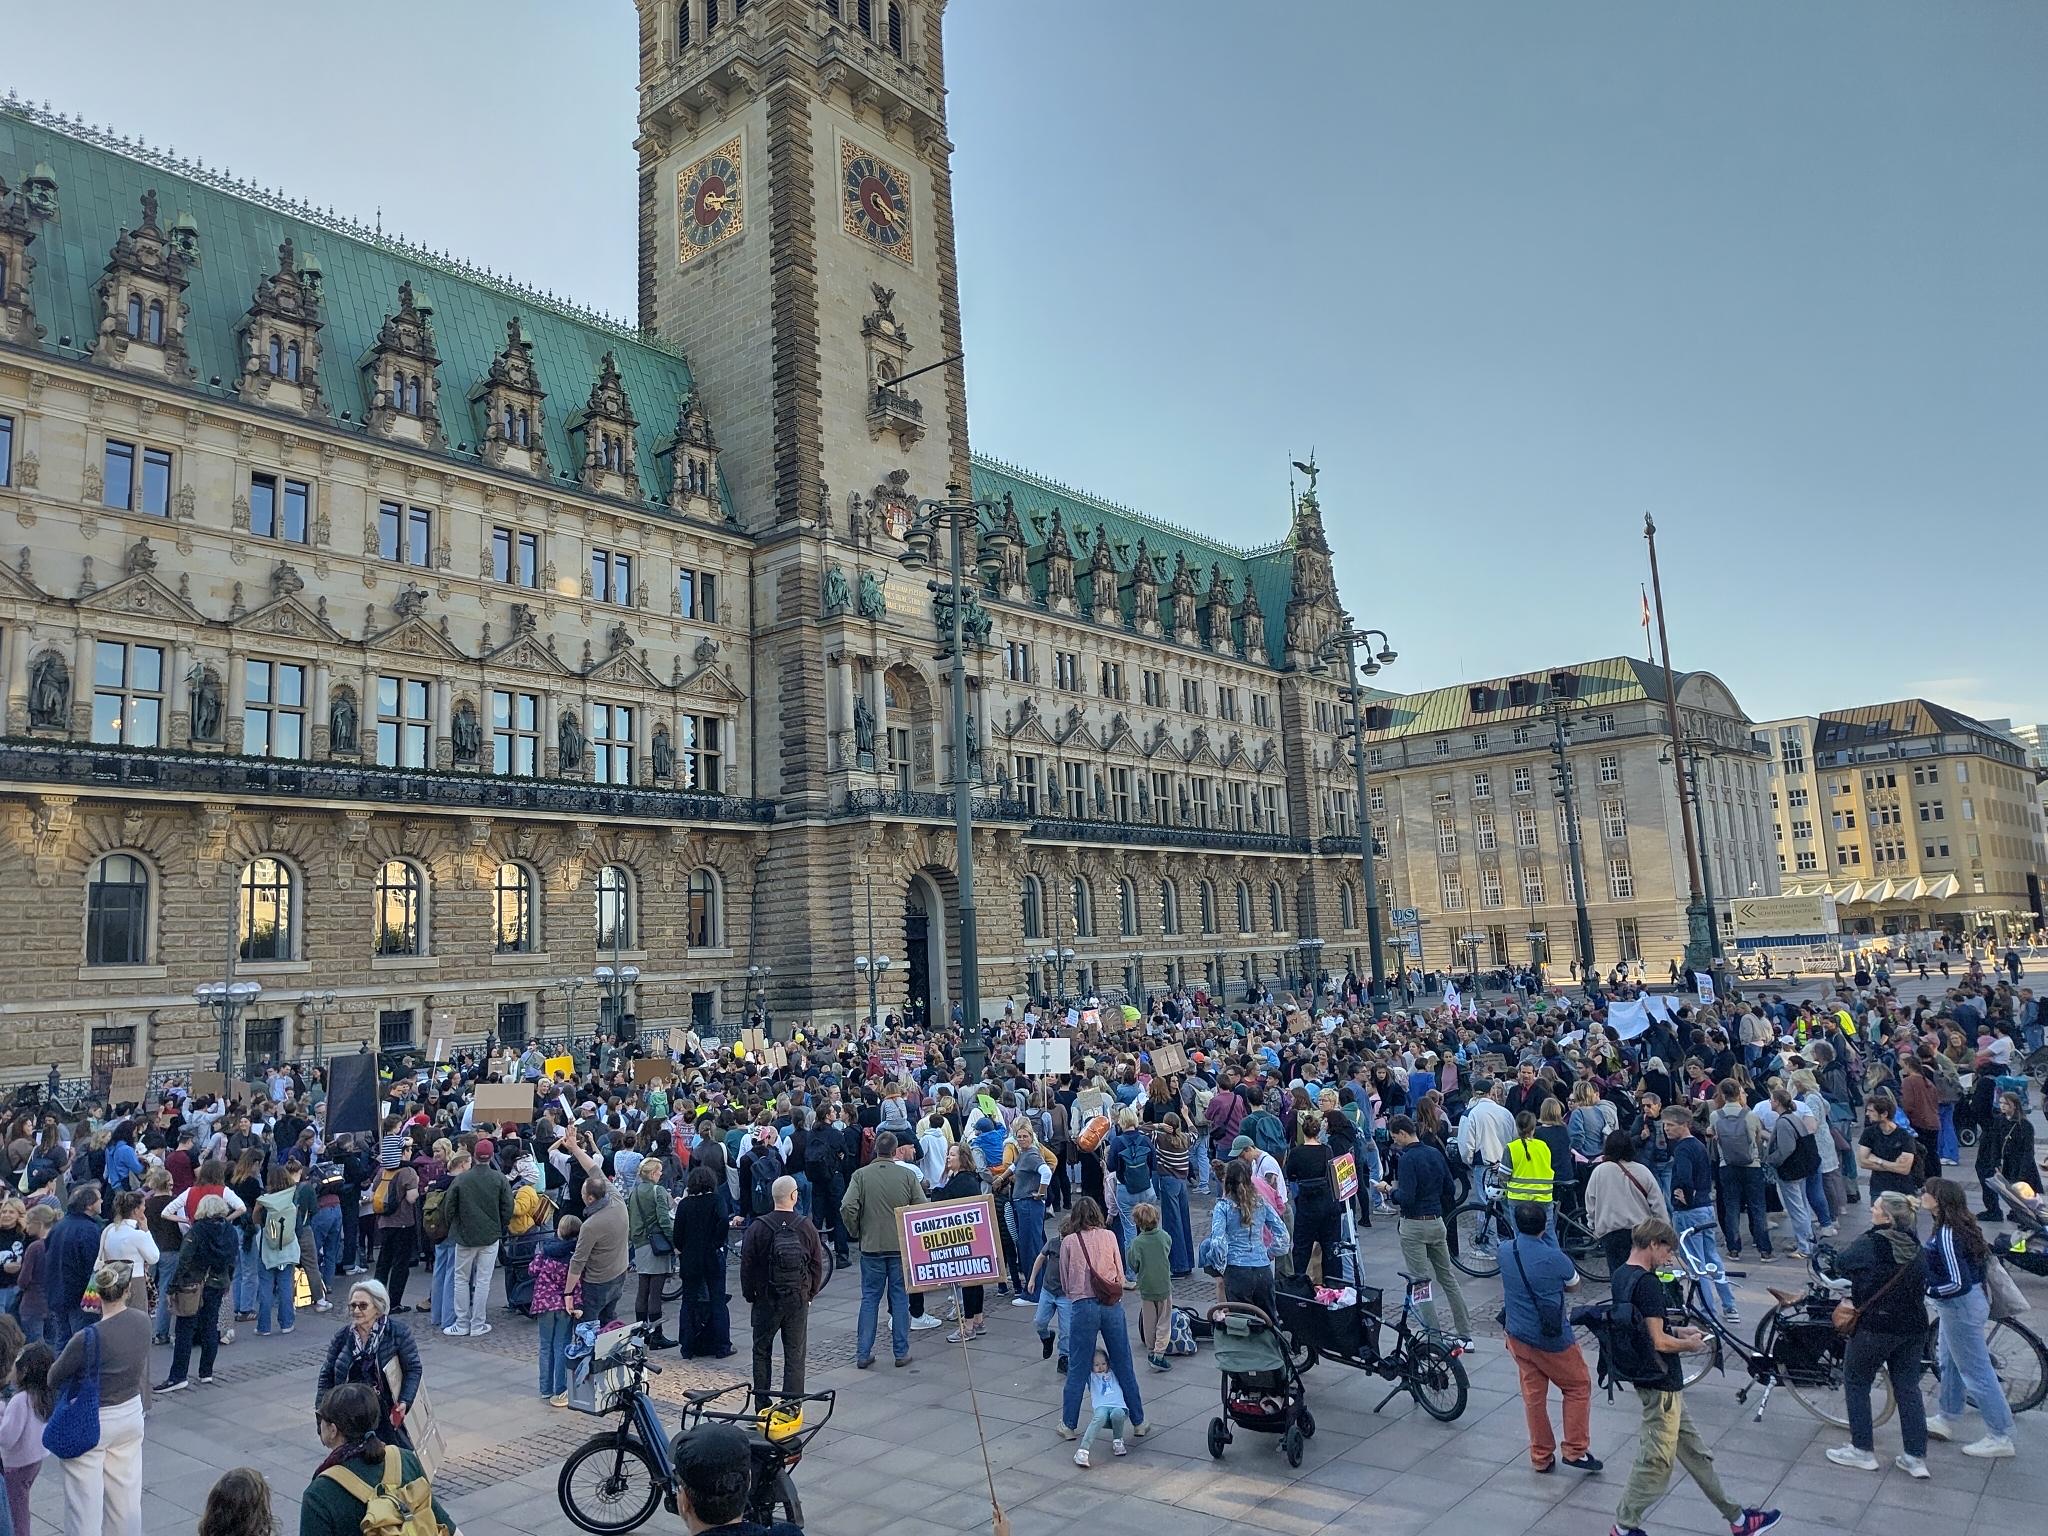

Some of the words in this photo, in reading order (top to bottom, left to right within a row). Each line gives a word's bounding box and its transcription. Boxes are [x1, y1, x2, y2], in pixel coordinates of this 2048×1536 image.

[914, 1214, 962, 1234] GANZTAG
[963, 1210, 980, 1224] IST
[922, 1226, 974, 1250] BILDUNG
[930, 1249, 953, 1262] NICHT
[954, 1245, 970, 1257] NUR
[917, 1257, 991, 1281] BETREUUNG
